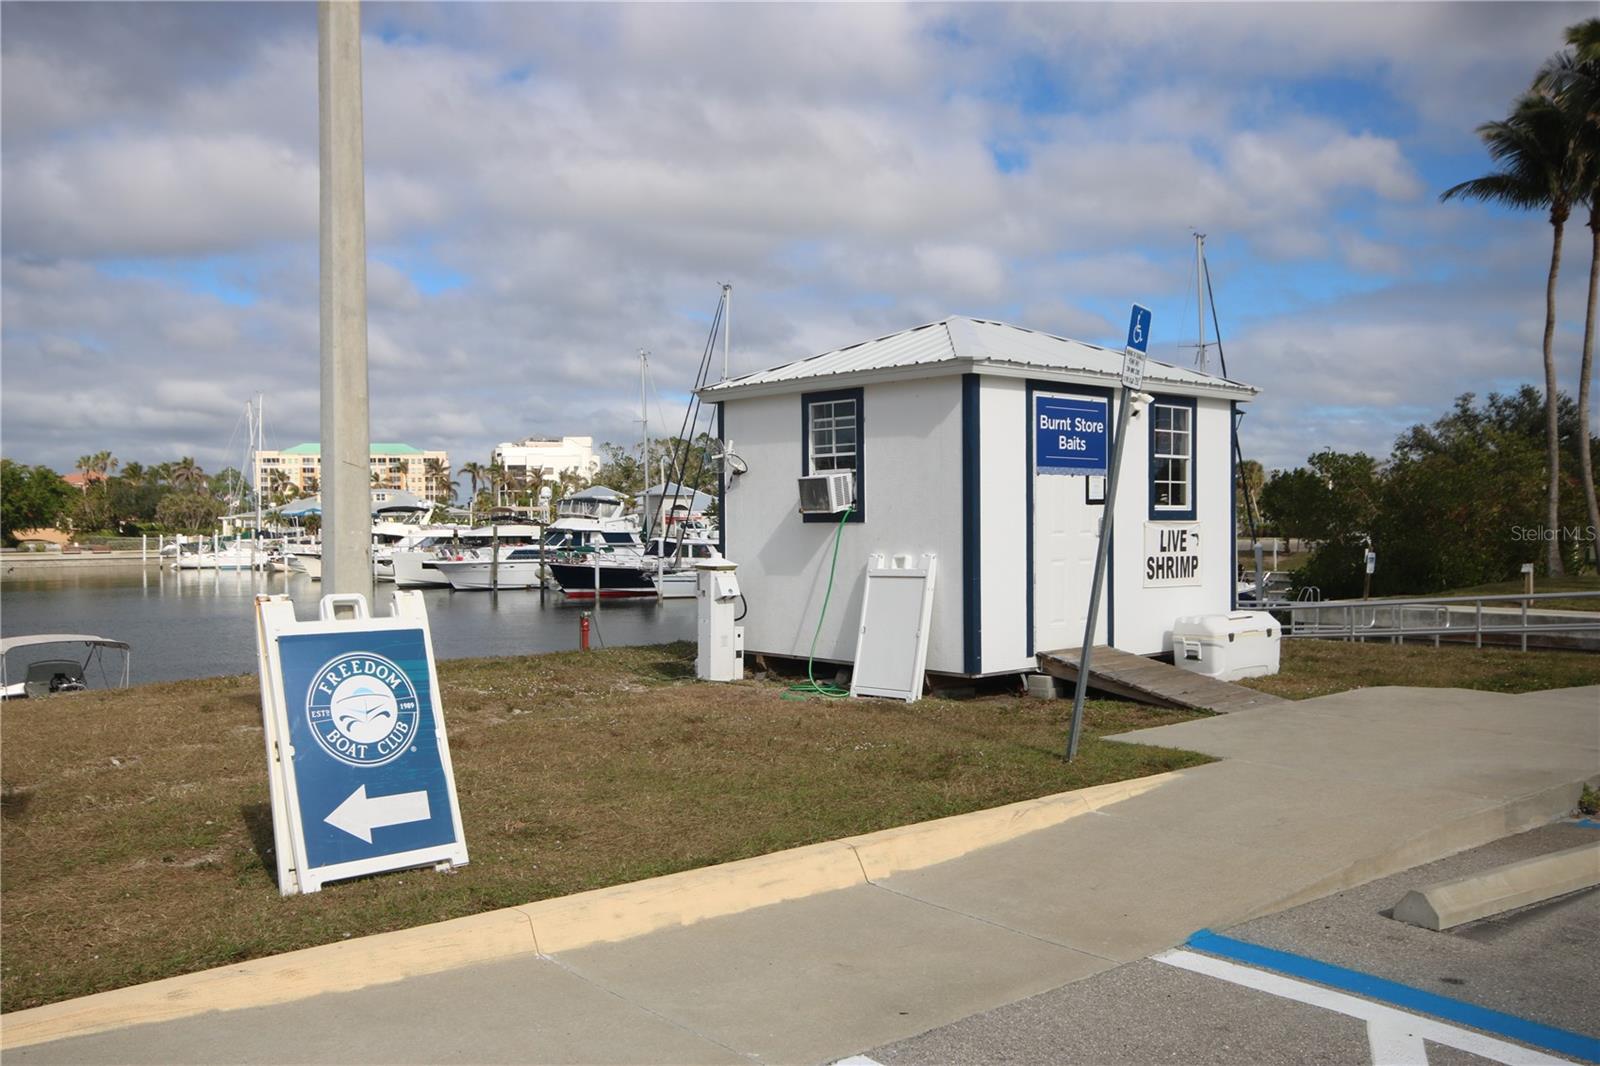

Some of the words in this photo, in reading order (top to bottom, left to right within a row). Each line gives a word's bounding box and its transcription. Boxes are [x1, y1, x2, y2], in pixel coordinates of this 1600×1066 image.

[1040, 414, 1072, 431] Burnt
[1074, 417, 1104, 433] Store
[1058, 435, 1087, 451] Baits
[1160, 529, 1187, 552] LIVE
[1146, 556, 1199, 580] SHRIMP
[318, 660, 402, 695] FREEDOM
[326, 728, 368, 759] BOAT
[376, 720, 409, 756] CLUB
